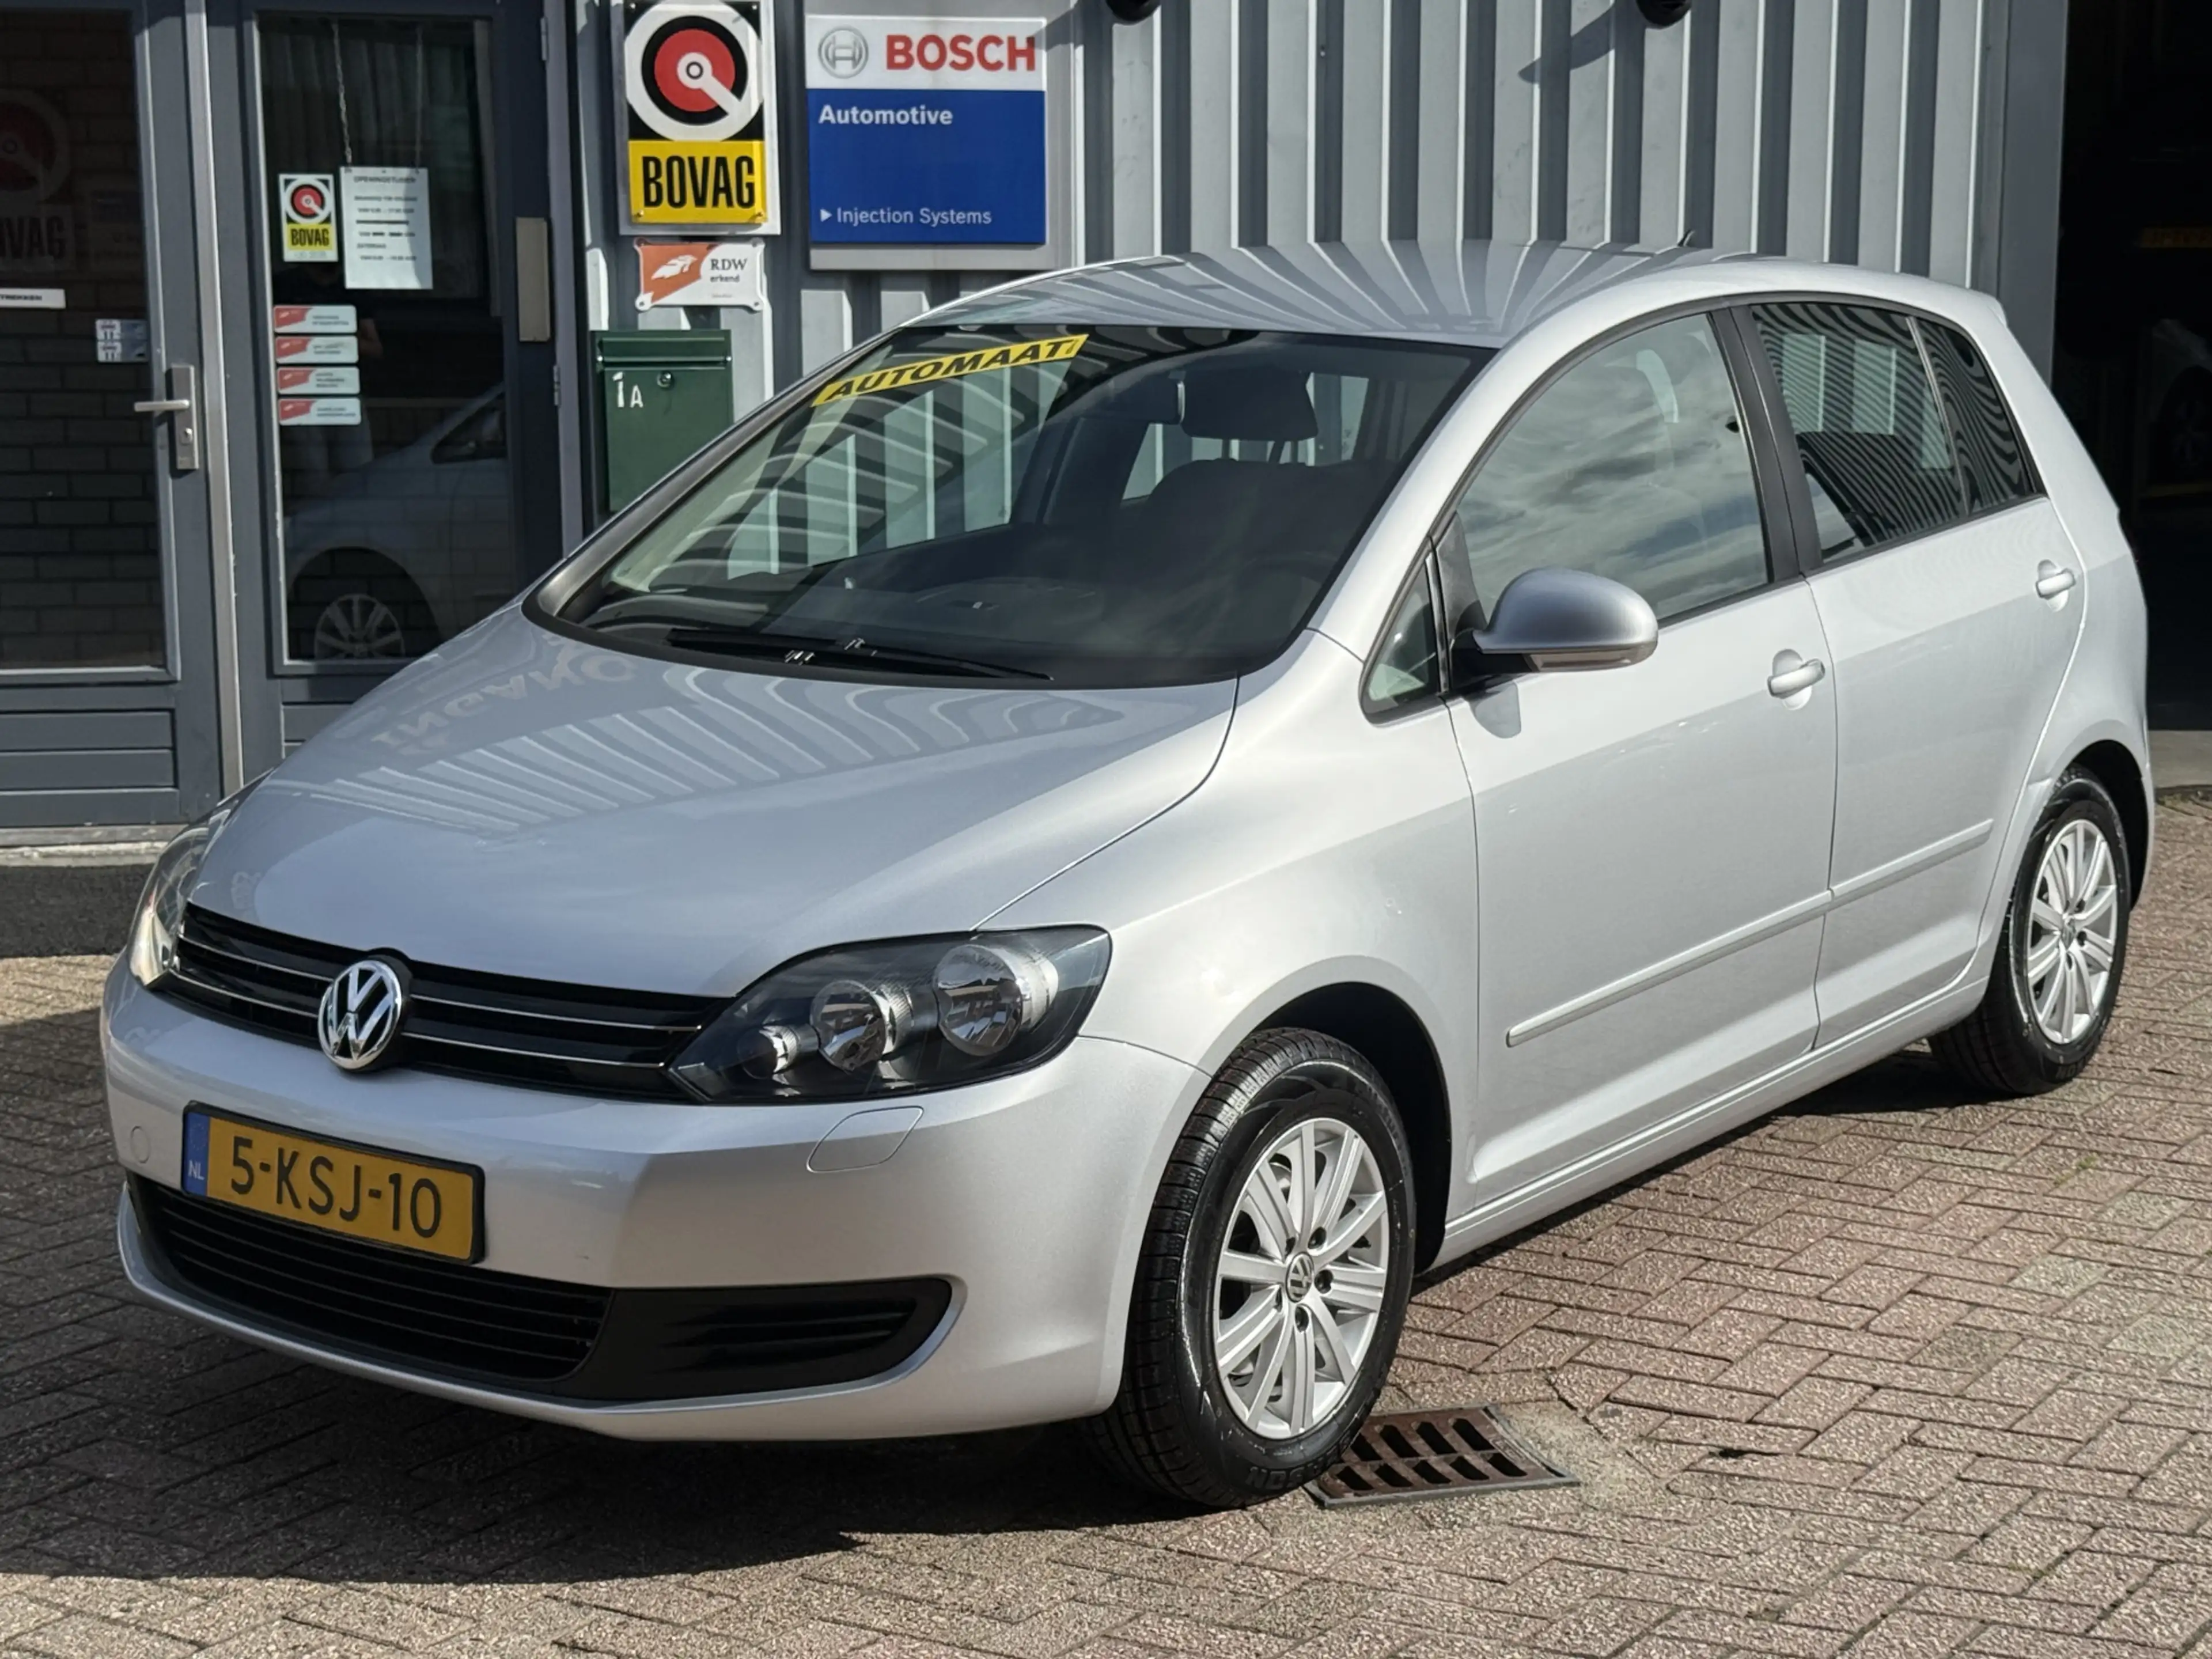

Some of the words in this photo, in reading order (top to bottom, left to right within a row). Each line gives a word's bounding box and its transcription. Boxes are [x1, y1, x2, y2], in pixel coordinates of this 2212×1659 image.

[887, 35, 1036, 71] BOSCH
[819, 104, 953, 125] Automotive
[642, 155, 755, 209] BOVAG
[837, 207, 914, 227] Injection
[920, 207, 992, 228] Systems
[291, 228, 329, 247] BOVAG
[710, 258, 748, 271] RDW
[188, 1160, 205, 1181] NL
[231, 1135, 441, 1238] 5-KSJ-10
